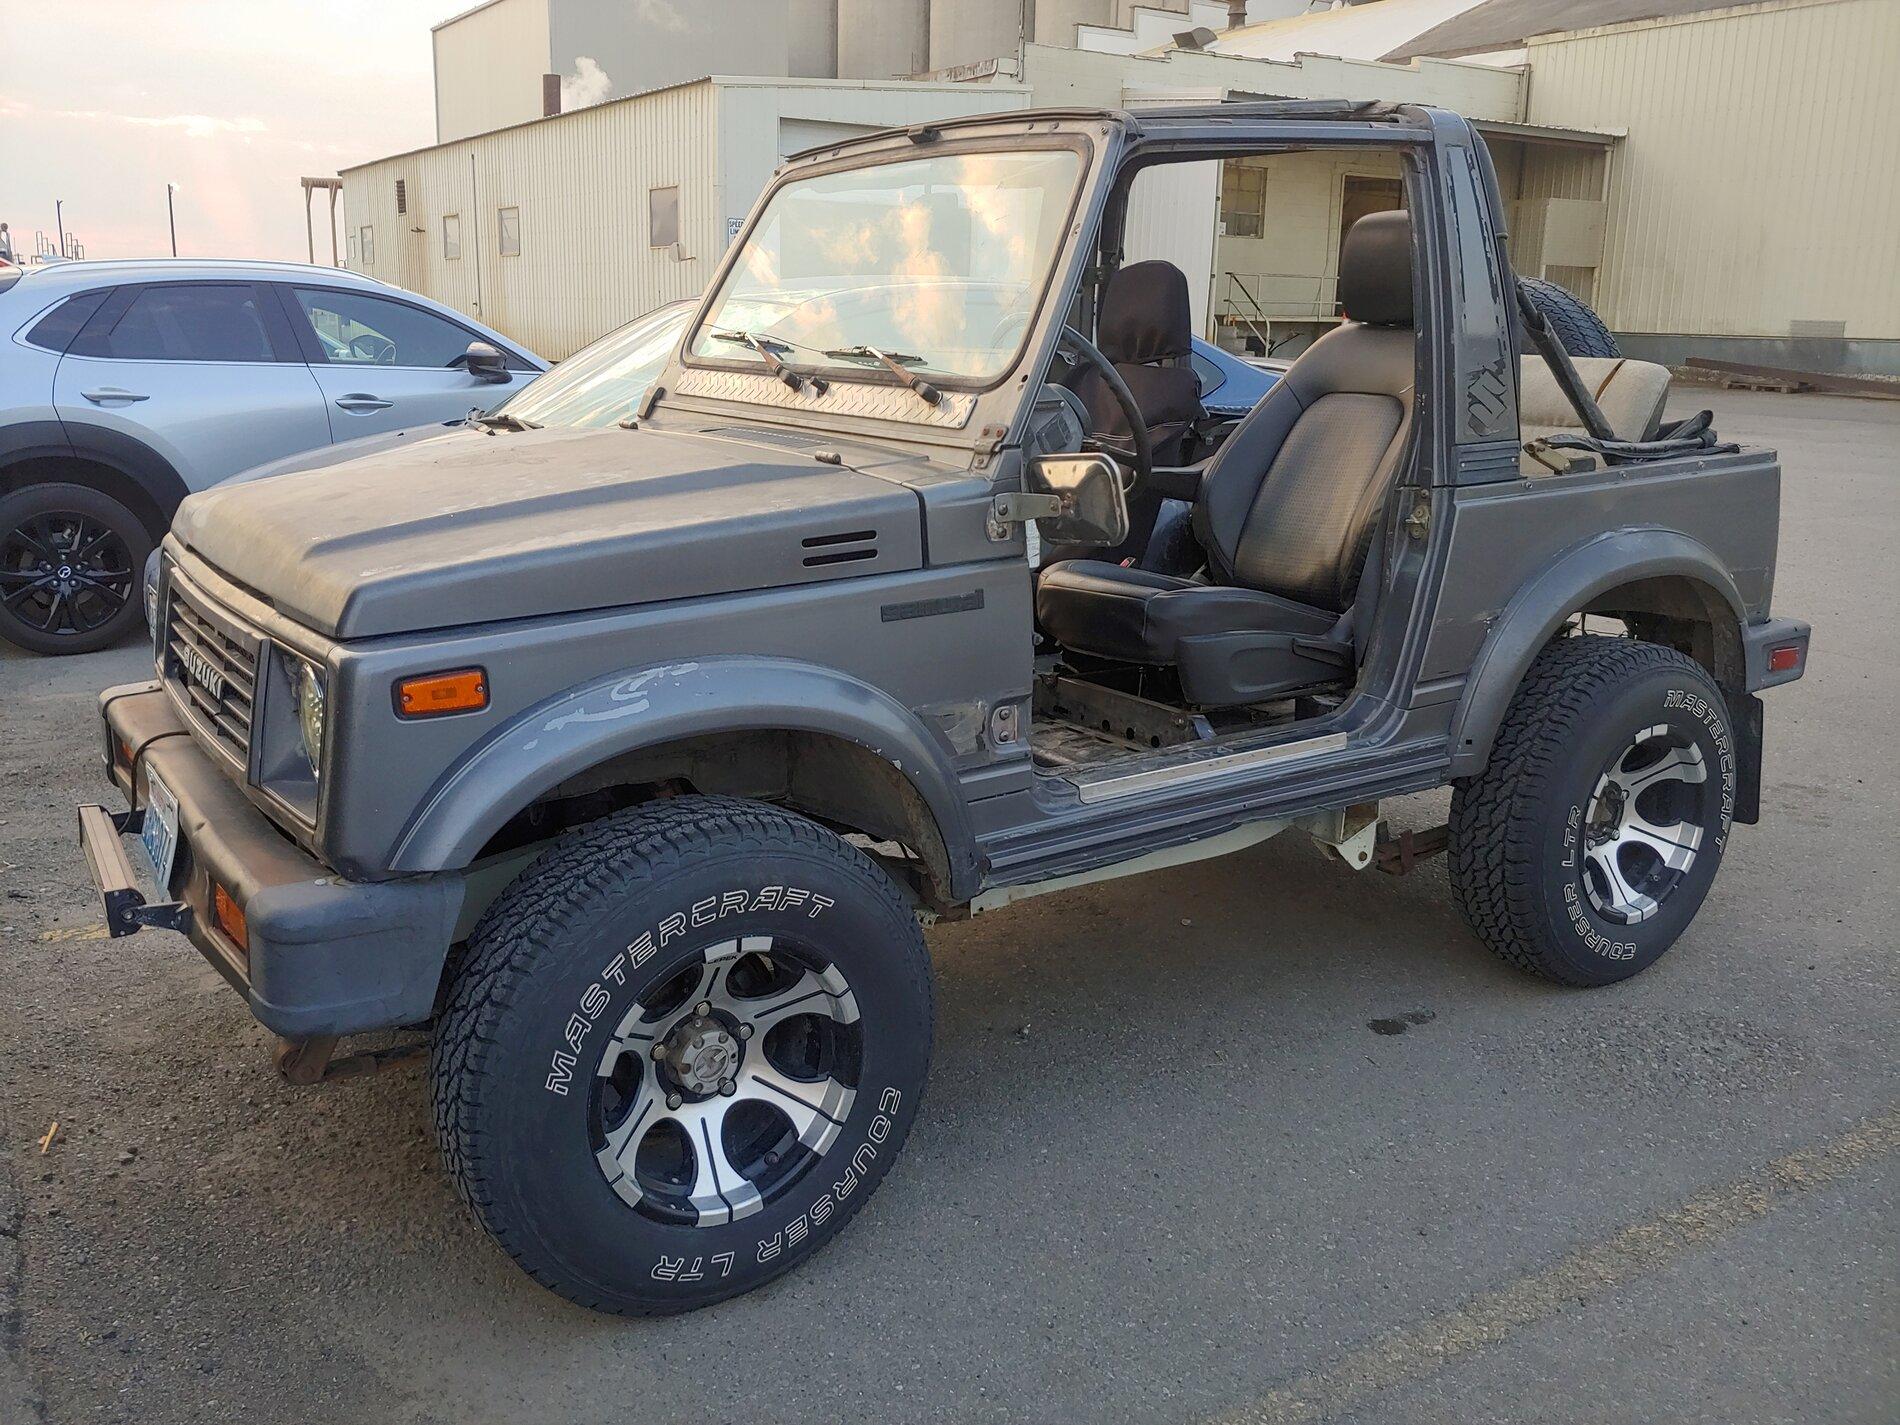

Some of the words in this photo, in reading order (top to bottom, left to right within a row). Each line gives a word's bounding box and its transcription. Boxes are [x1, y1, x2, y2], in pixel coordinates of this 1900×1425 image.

[184, 644, 224, 700] SUZUKI
[1664, 689, 1734, 854] MASTERCRAFT
[1560, 804, 1582, 868] LTR
[1564, 882, 1637, 961] COURSER
[544, 885, 836, 1097] MASTERCRAFT
[756, 1086, 902, 1263] COURSER
[651, 1250, 736, 1283] LTR
